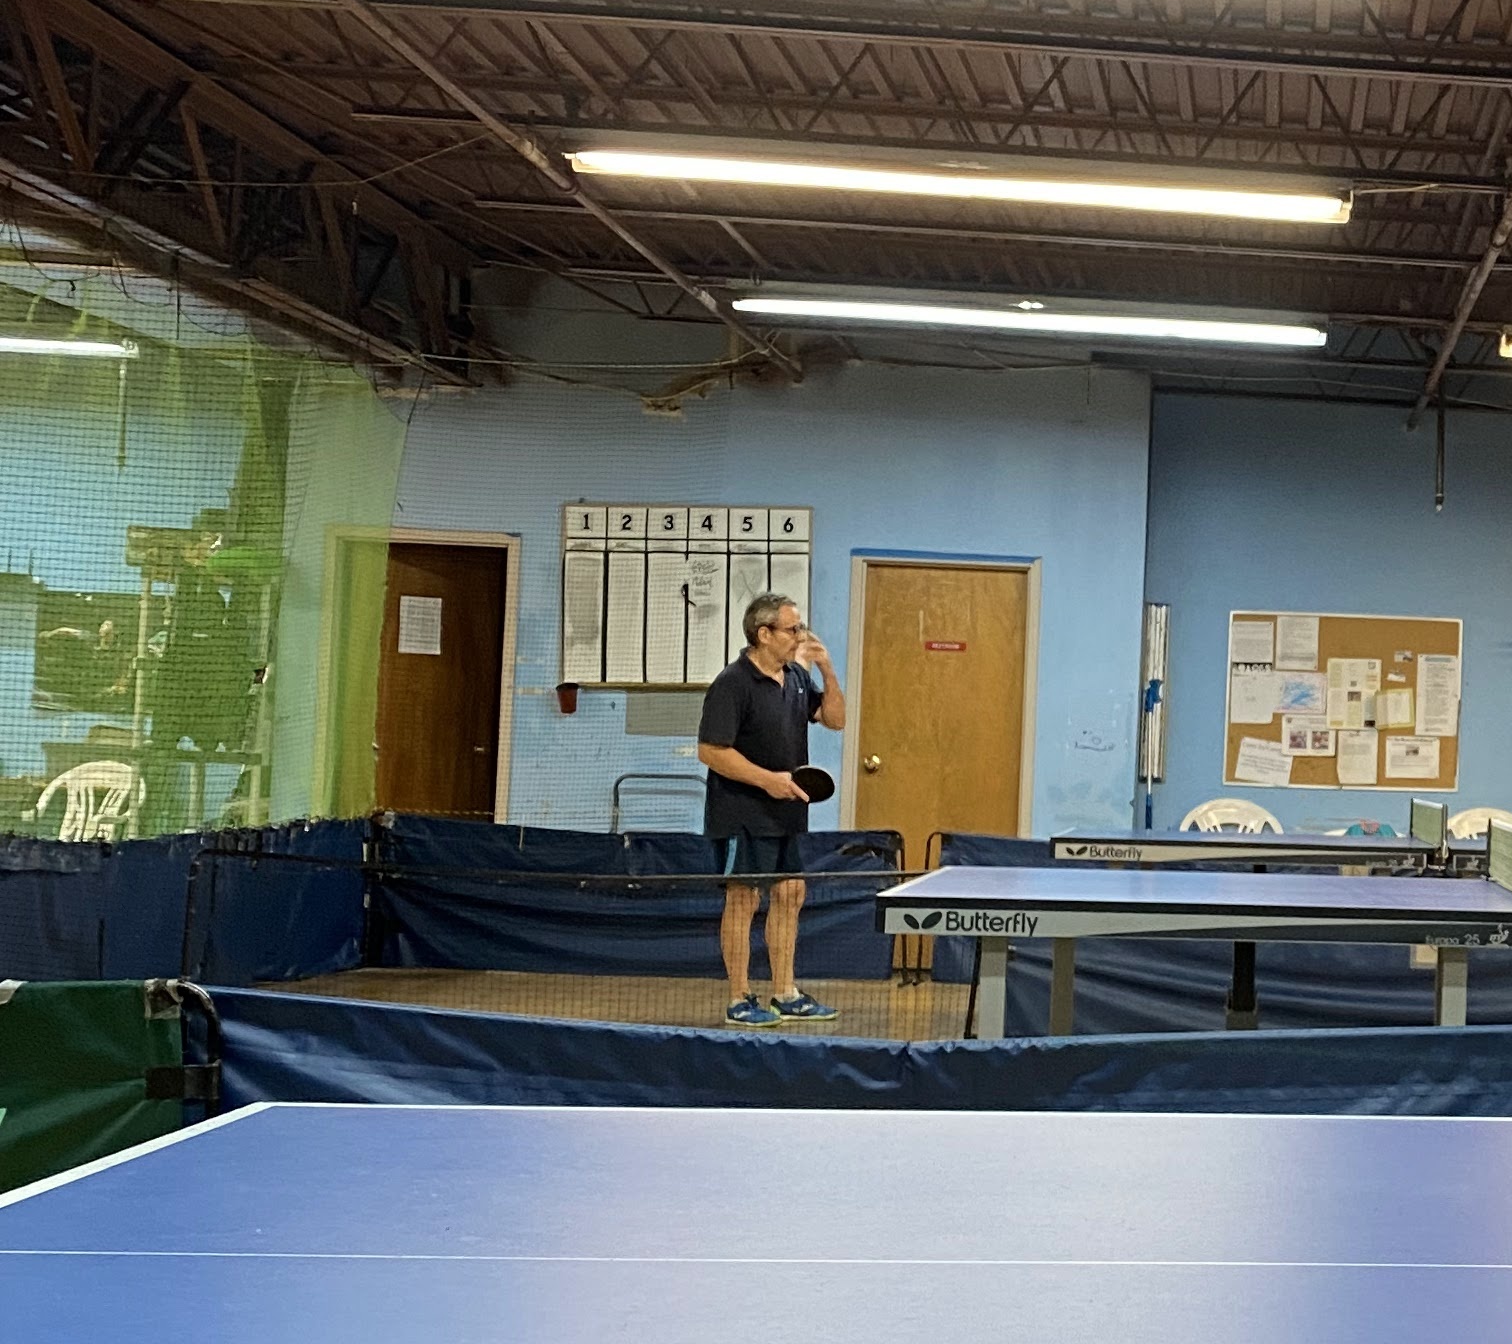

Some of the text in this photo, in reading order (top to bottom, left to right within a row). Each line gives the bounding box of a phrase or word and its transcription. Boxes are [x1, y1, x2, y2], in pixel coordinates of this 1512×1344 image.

[583, 513, 794, 533] 1 2 3 4 5 6
[1089, 845, 1143, 860] Butterfly
[945, 911, 1039, 936] Butterfly
[1464, 933, 1481, 946] 25
